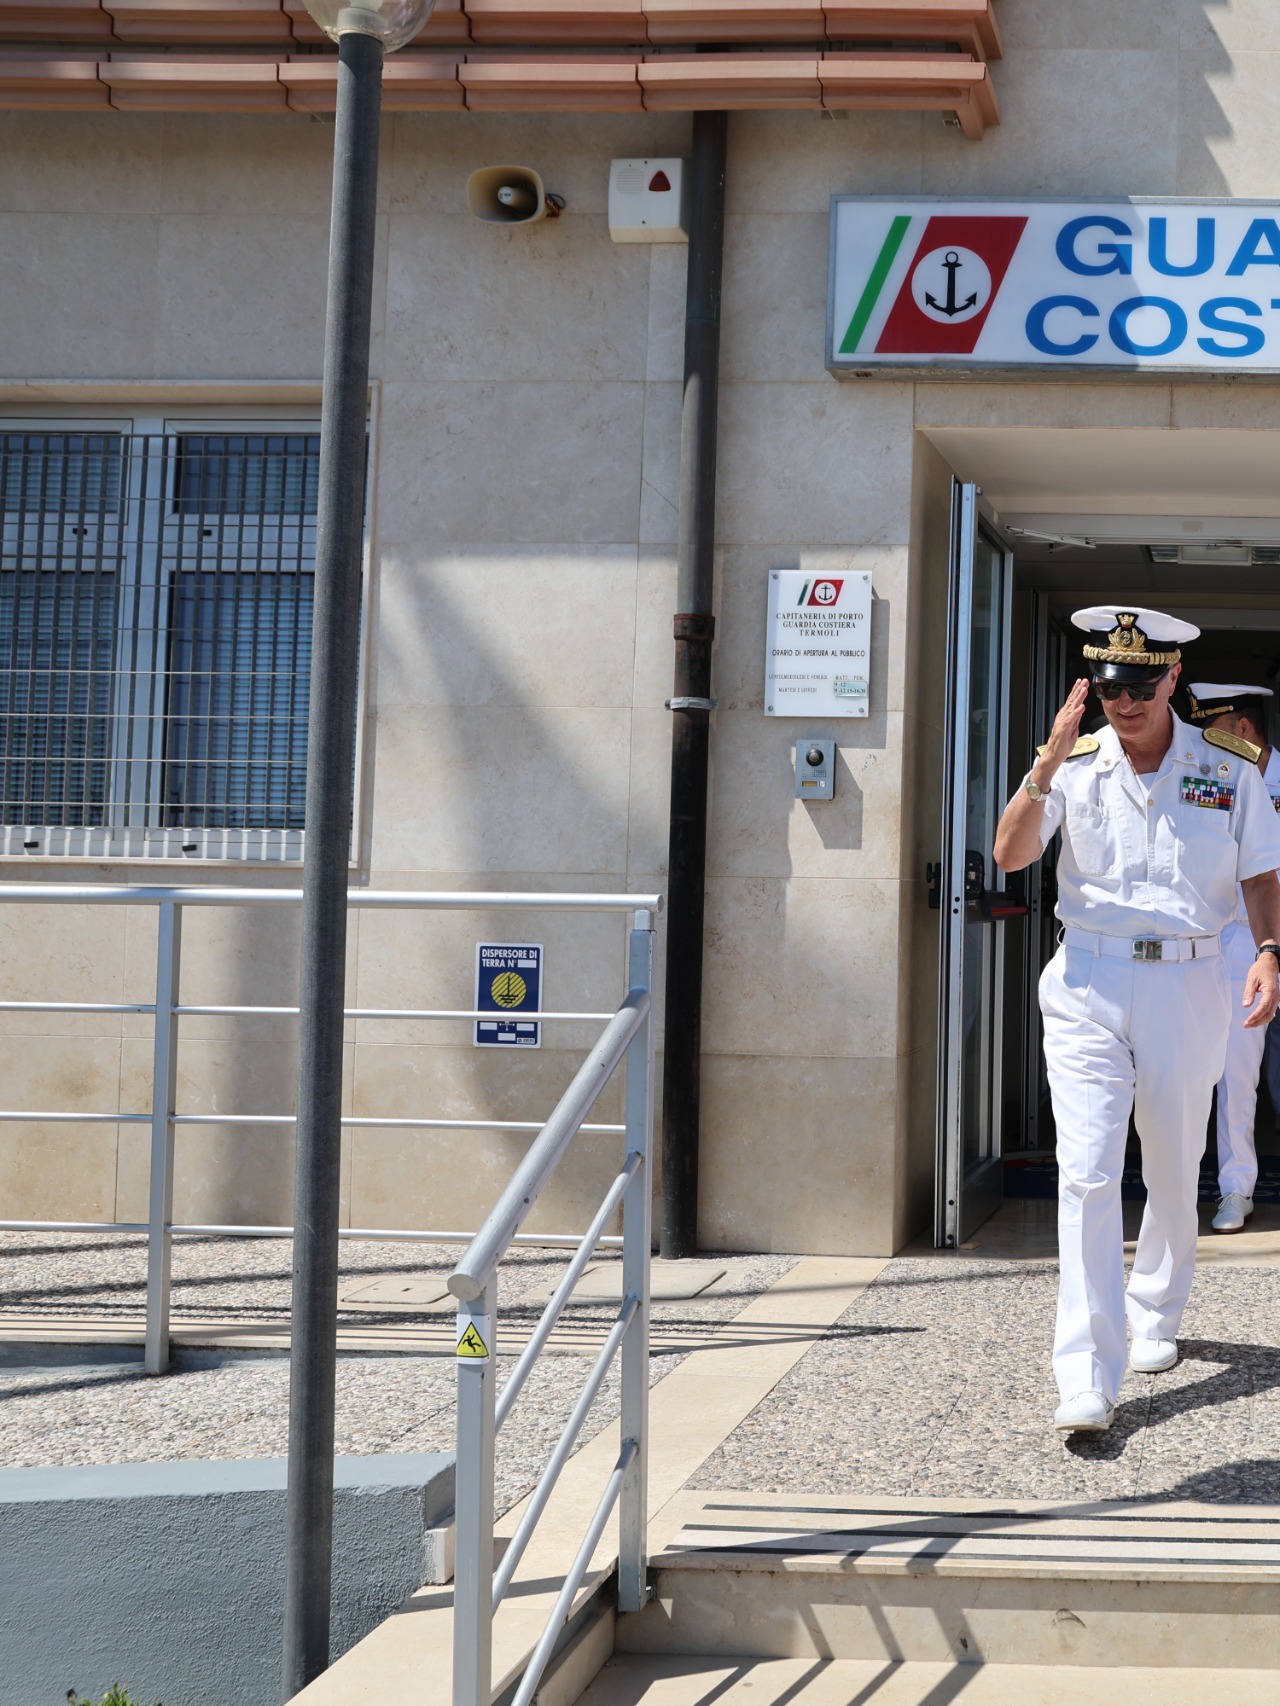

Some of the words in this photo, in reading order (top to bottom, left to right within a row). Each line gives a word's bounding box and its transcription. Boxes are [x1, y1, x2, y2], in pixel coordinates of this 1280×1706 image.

[776, 612, 826, 620] CAPITANERIA
[828, 612, 837, 620] DI
[482, 949, 527, 958] DISPERSORE
[529, 950, 537, 959] DI
[482, 959, 506, 968] TERRA
